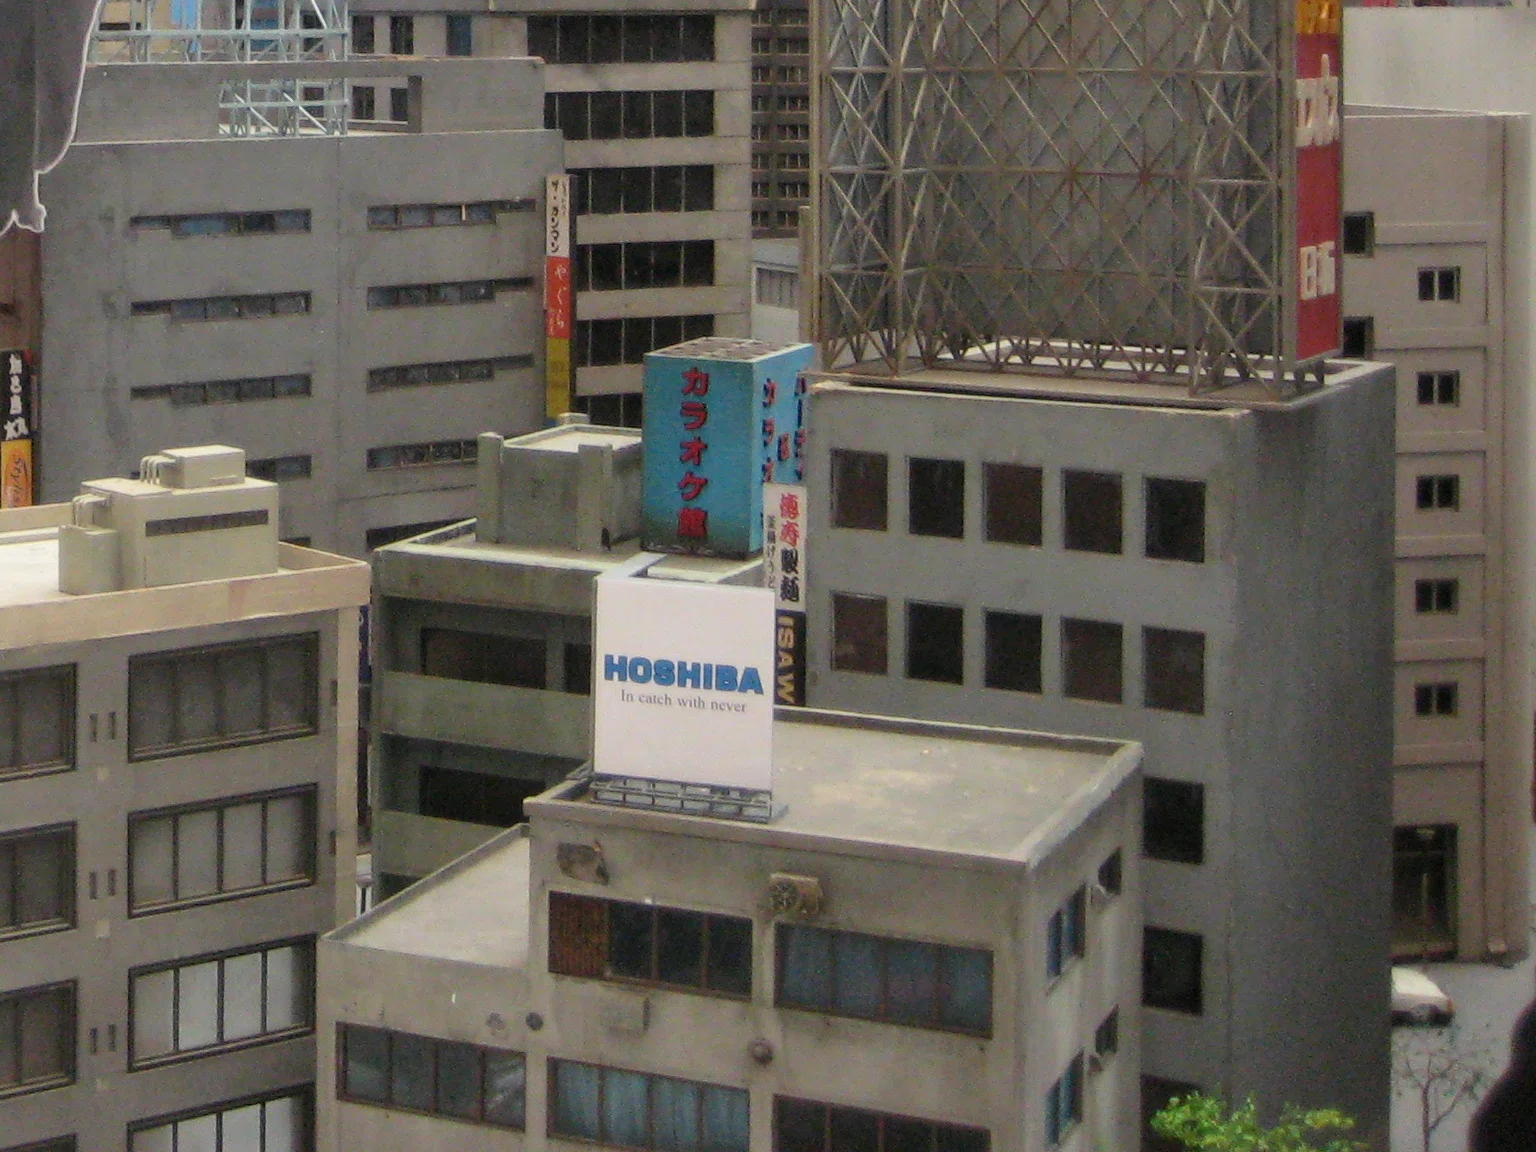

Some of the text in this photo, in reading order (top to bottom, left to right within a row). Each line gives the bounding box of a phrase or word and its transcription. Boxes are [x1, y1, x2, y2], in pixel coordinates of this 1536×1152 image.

[604, 654, 764, 696] HOSHIBA
[620, 689, 748, 714] In catch with never
